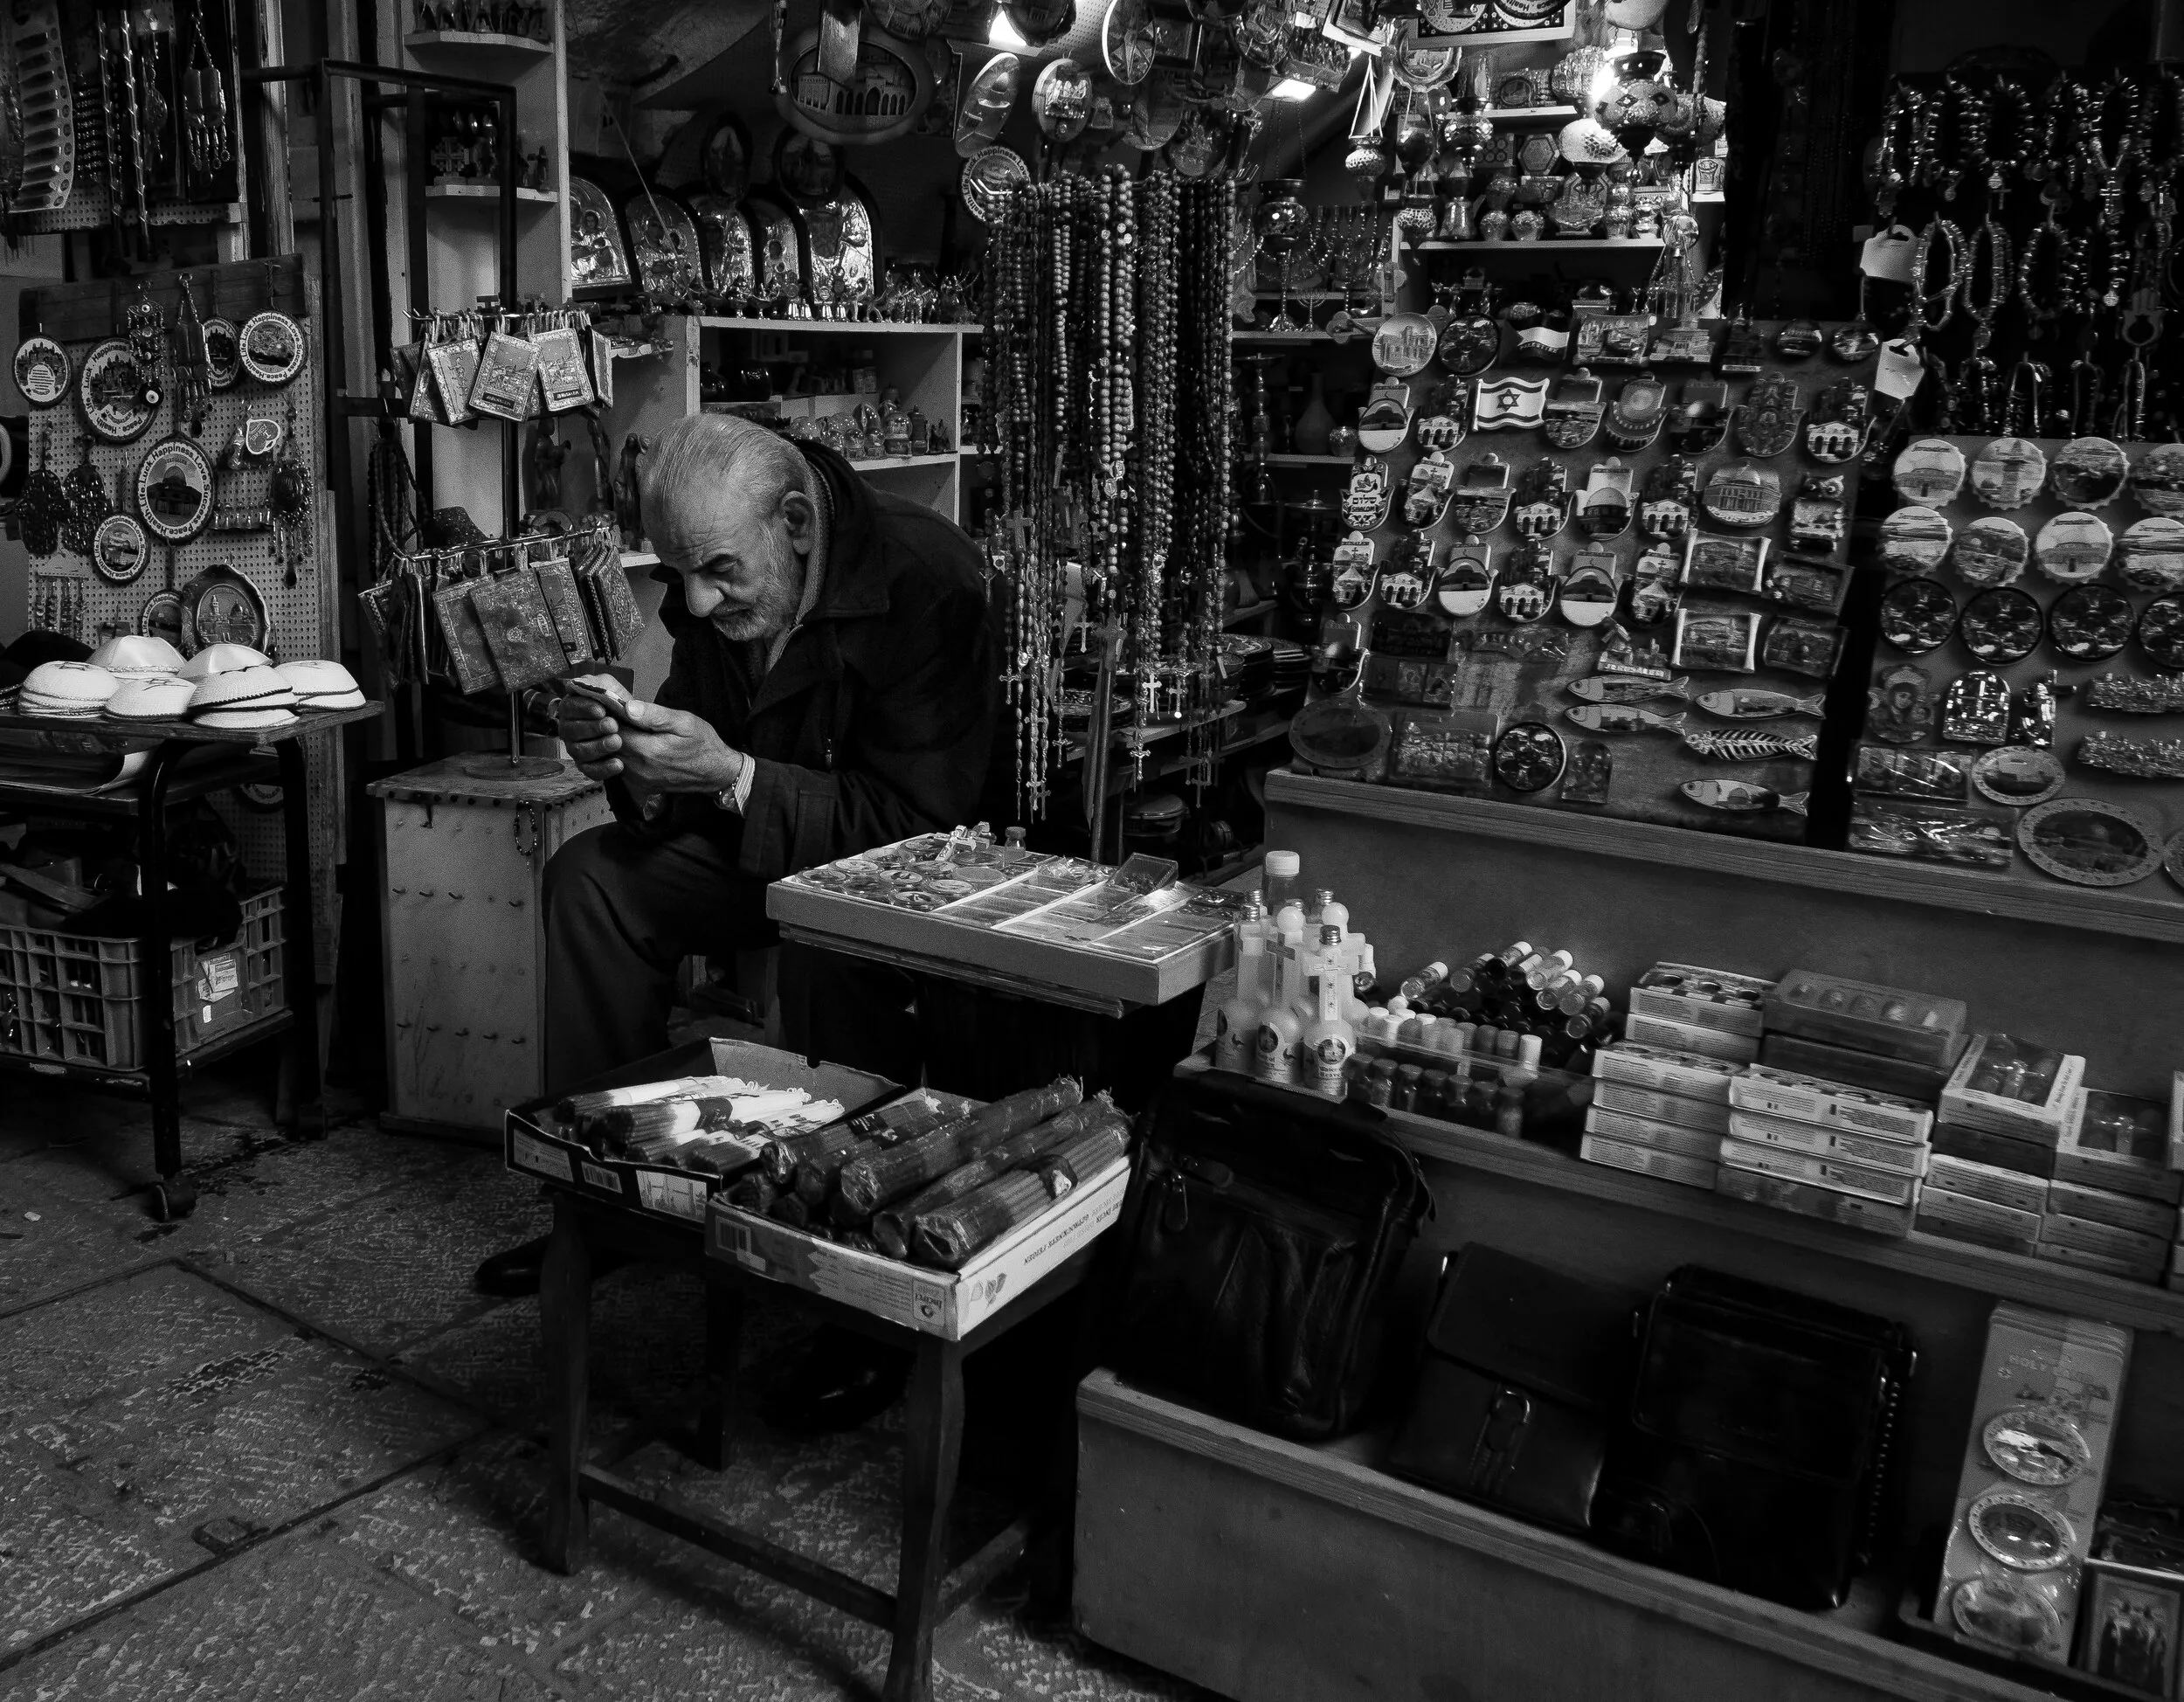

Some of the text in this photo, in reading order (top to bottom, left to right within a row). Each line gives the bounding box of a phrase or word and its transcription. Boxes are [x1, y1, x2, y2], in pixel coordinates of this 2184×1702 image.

[251, 314, 289, 325] Happiness
[287, 323, 301, 342] Love
[151, 443, 194, 460] Happiness
[139, 460, 153, 484] Luck
[193, 455, 207, 481] Love
[193, 483, 211, 523] Success
[1351, 495, 1378, 505] שלום
[144, 508, 167, 534] Health
[169, 522, 193, 535] Peace
